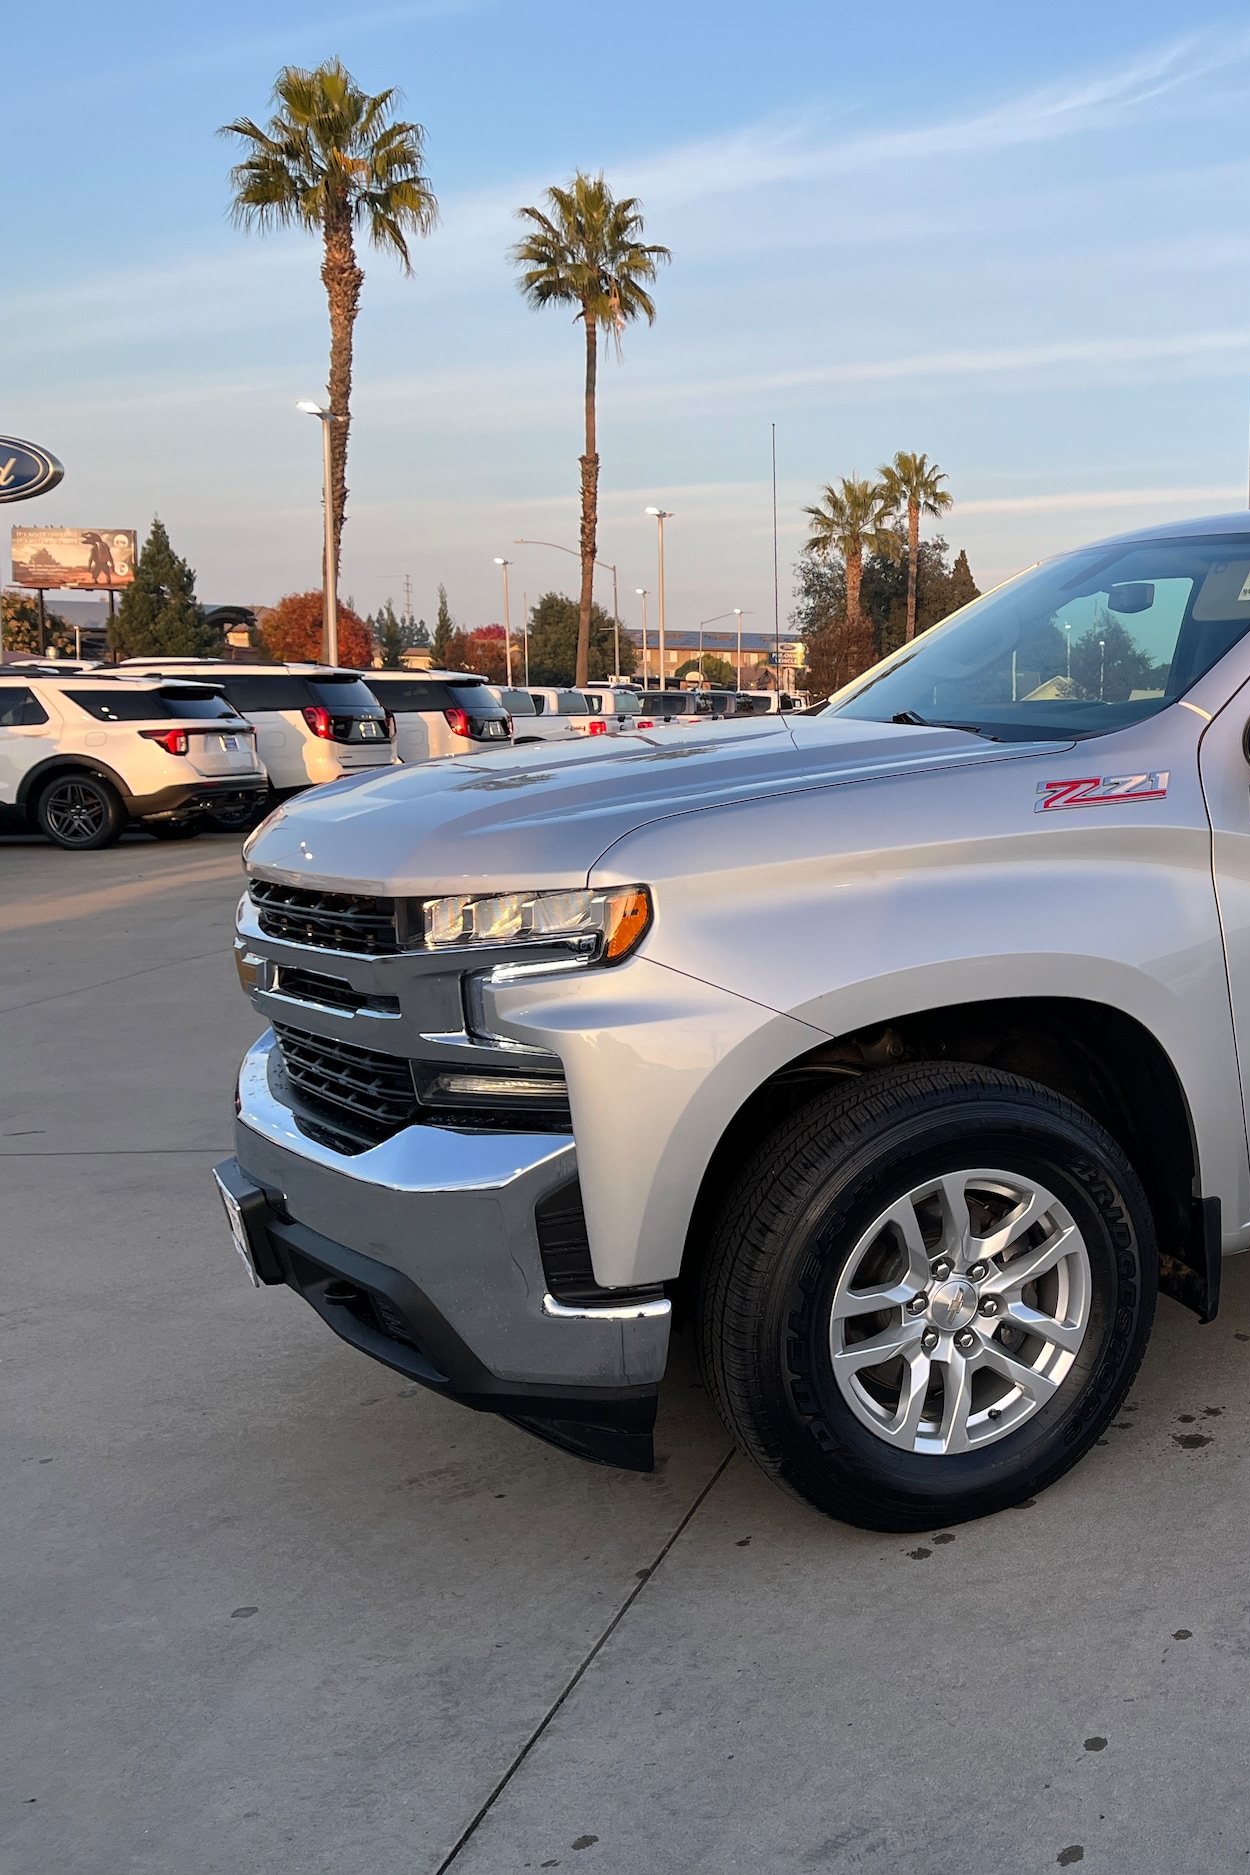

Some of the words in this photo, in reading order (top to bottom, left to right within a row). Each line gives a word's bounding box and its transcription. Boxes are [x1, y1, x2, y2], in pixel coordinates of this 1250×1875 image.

[1034, 770, 1171, 813] Z71
[785, 1207, 848, 1453] DUELER
[1062, 1153, 1138, 1447] BRIDGESTONE
